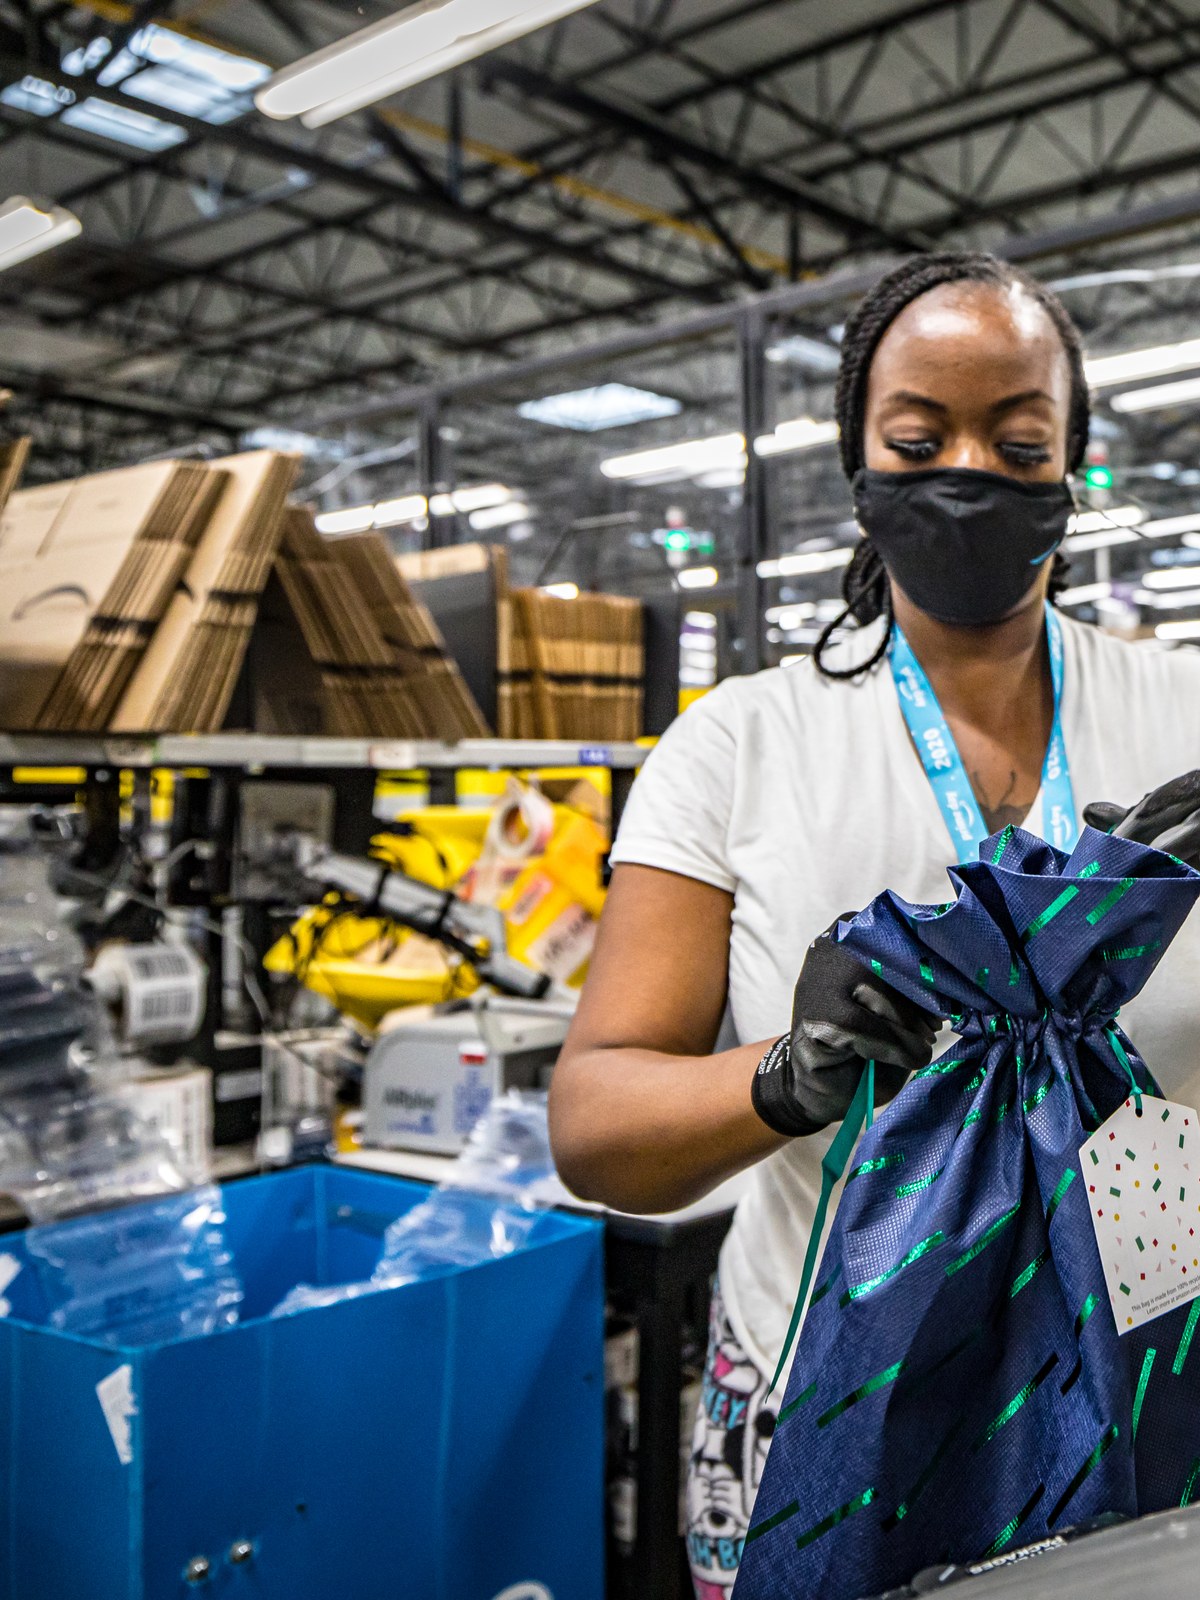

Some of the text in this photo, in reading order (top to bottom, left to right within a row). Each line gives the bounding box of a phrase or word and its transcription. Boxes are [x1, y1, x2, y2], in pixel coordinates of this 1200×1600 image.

[923, 728, 952, 769] 2020
[1131, 1303, 1141, 1312] This
[1141, 1300, 1151, 1308] bag
[1154, 1292, 1167, 1301] made
[1166, 1287, 1177, 1296] from
[1177, 1281, 1189, 1290] 100%
[1147, 1306, 1159, 1314] Learn
[1159, 1299, 1171, 1308] more
